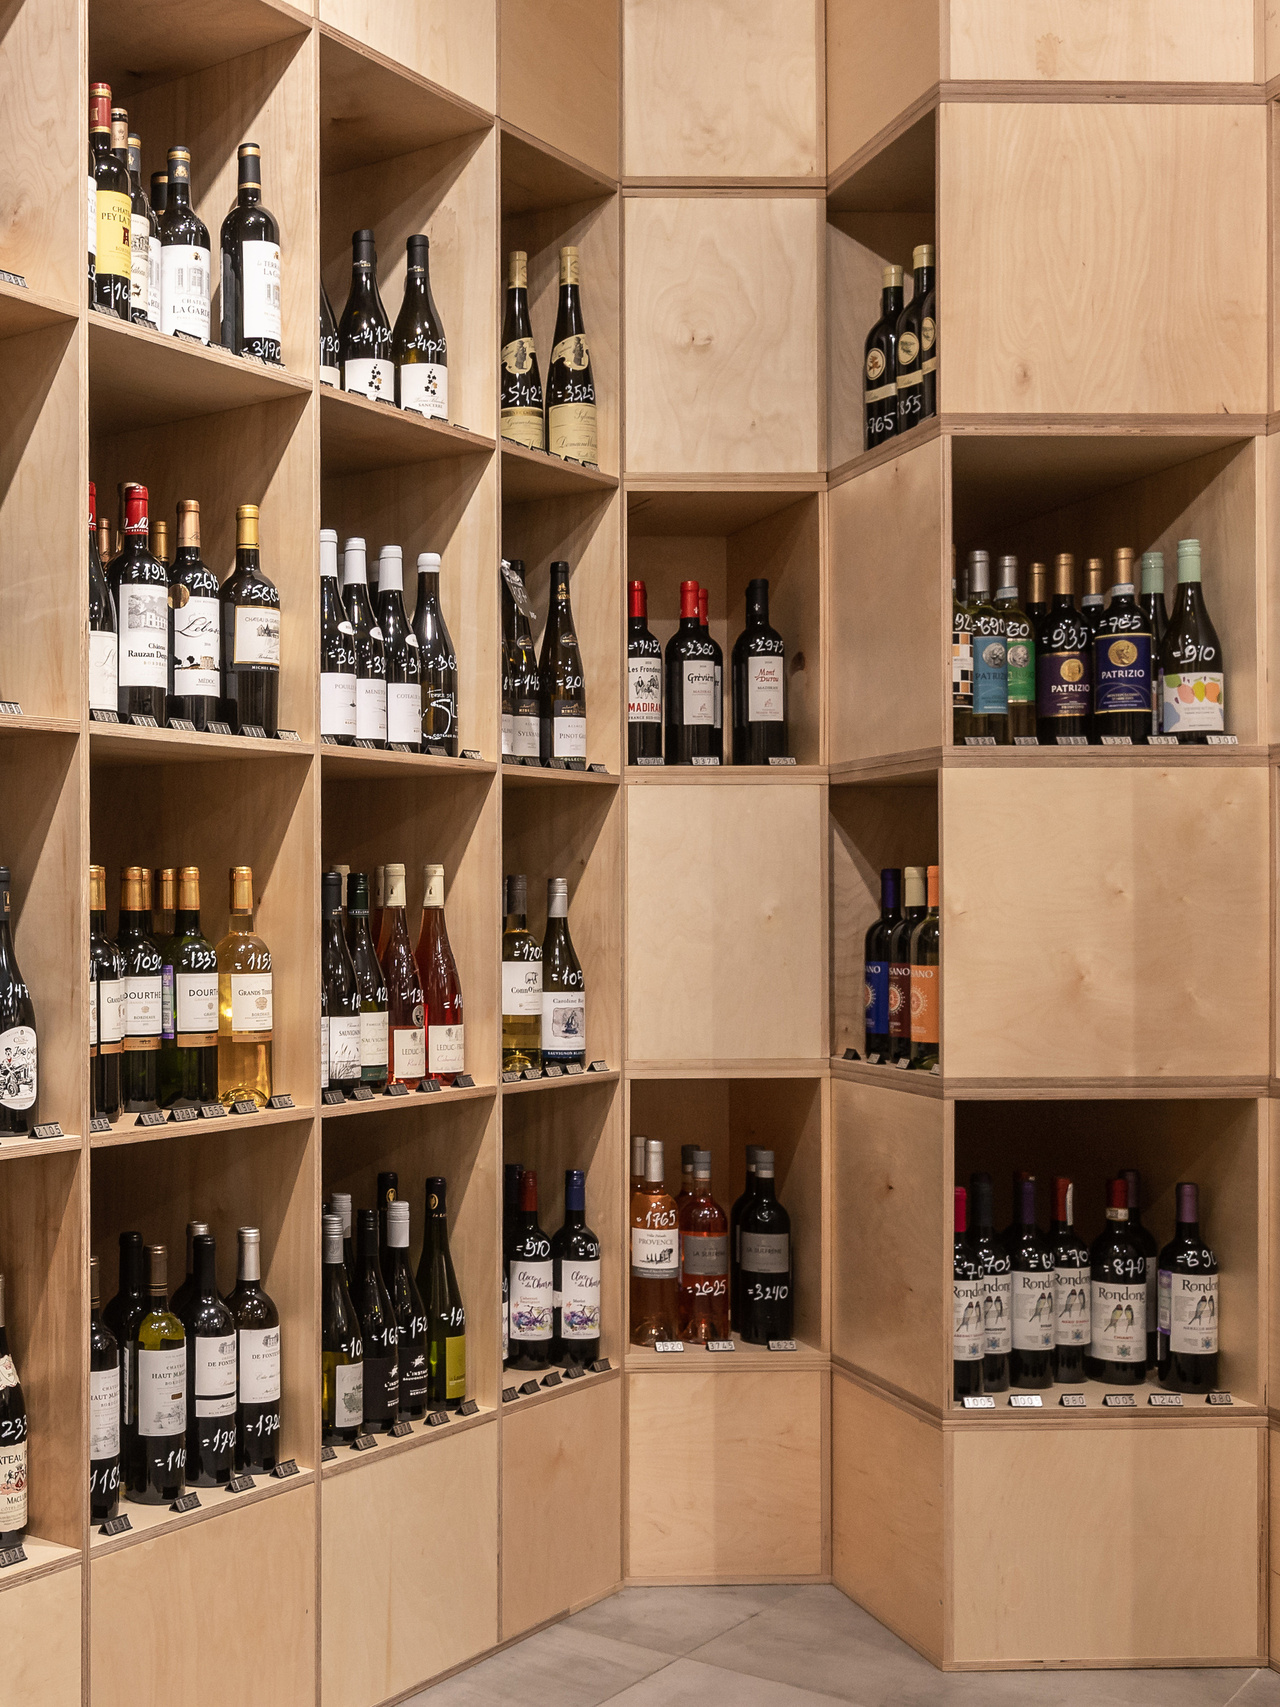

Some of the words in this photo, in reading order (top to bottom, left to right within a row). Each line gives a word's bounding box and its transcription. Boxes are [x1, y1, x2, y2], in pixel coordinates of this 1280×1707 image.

[172, 304, 185, 315] LA
[187, 306, 210, 318] GARDE
[128, 650, 155, 658] Rauzan
[1102, 669, 1145, 679] PATRIZIO
[1051, 684, 1090, 693] PATRIZIO
[559, 732, 577, 740] PINOT
[1209, 736, 1236, 744] 1300
[124, 991, 161, 999] DOURTHE
[273, 1095, 292, 1107] 1645
[203, 1104, 224, 1116] 1555
[142, 1112, 165, 1125] 1645
[36, 1125, 62, 1136] 2105
[966, 1398, 993, 1406] 1005
[1064, 1396, 1084, 1404] 980
[1108, 1397, 1135, 1405] 1005
